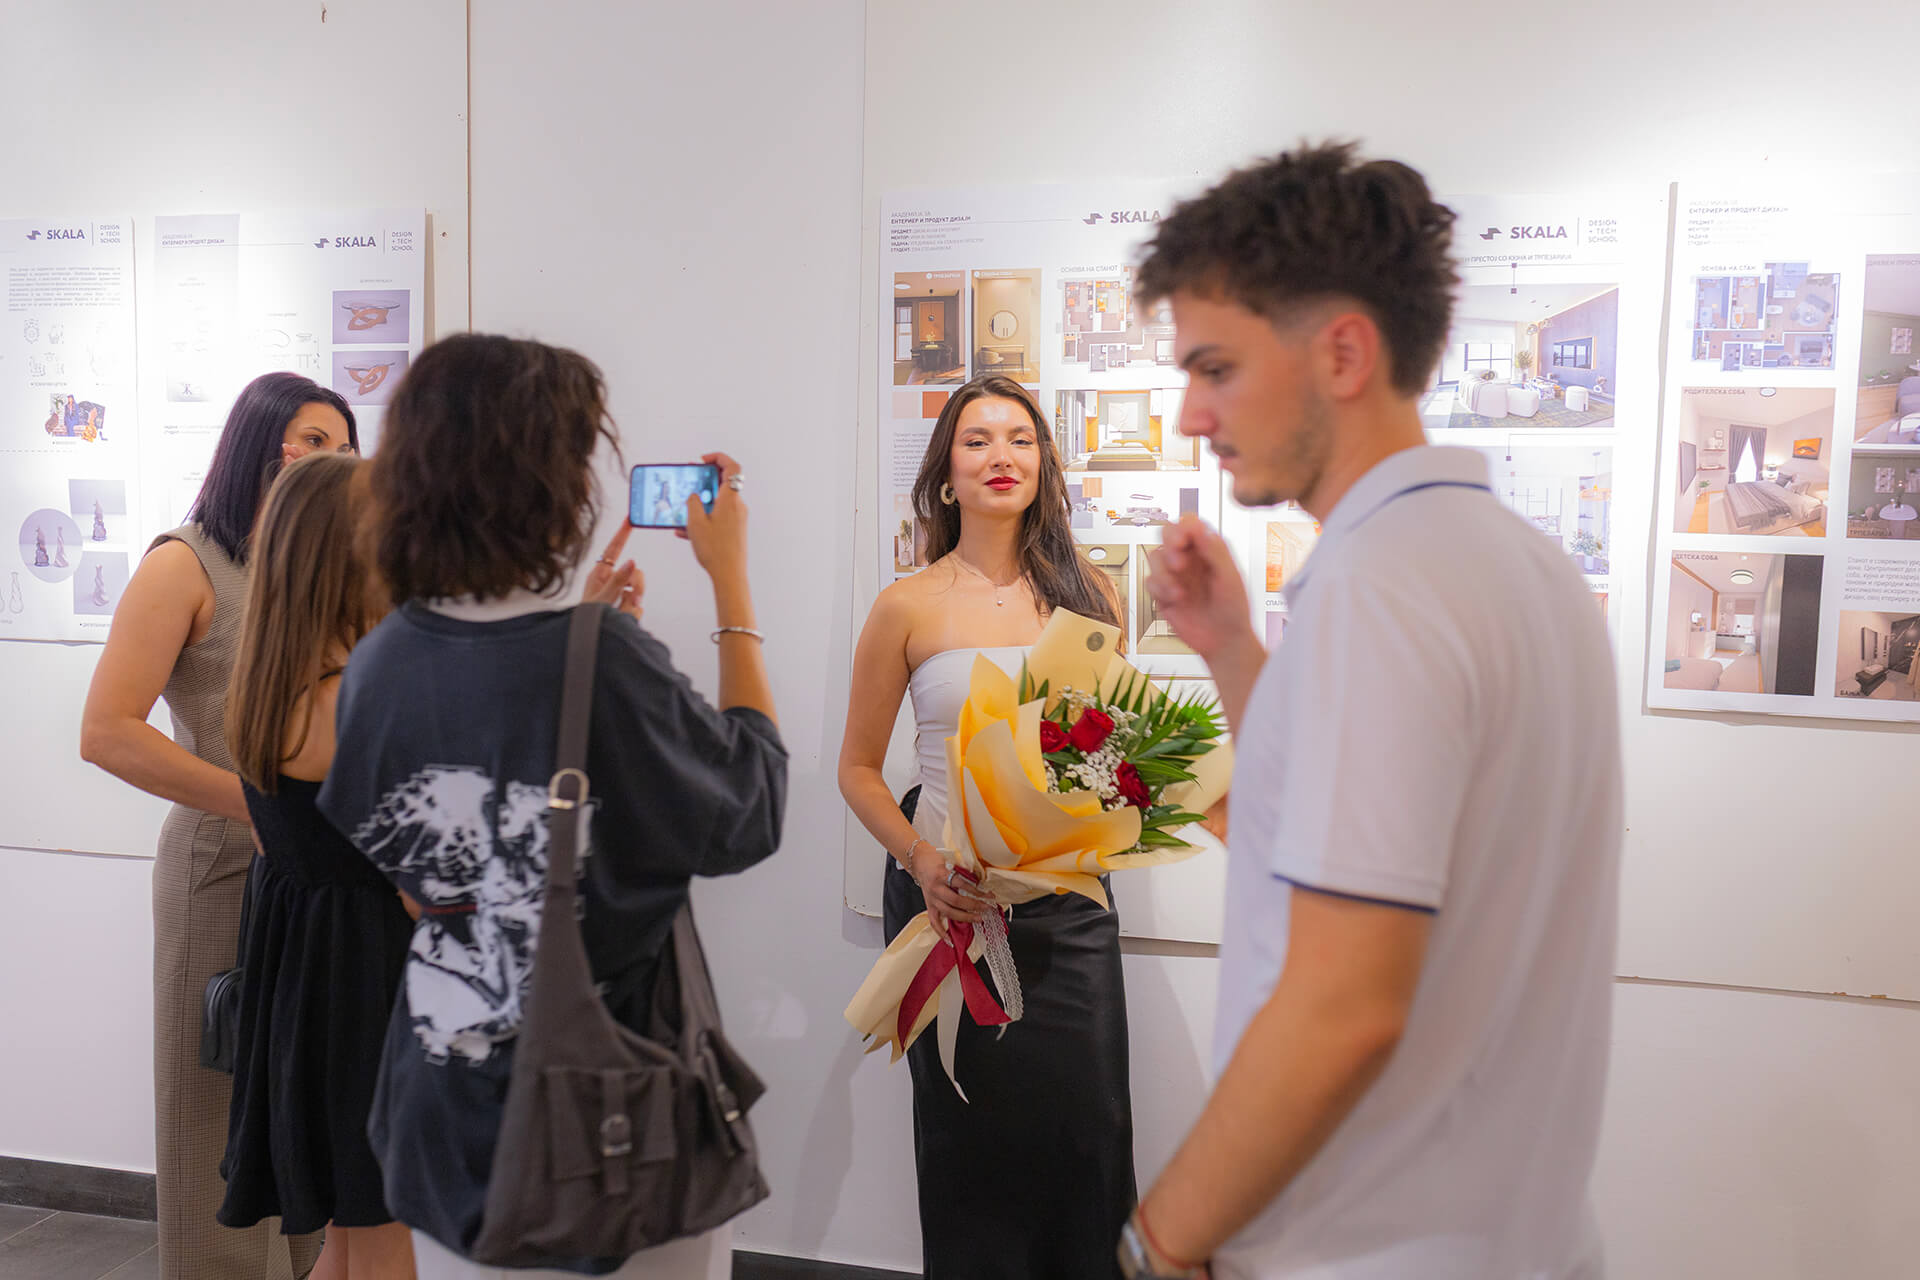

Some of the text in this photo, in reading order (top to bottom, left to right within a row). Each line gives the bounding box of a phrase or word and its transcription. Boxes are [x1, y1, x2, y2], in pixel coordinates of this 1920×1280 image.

[1110, 210, 1161, 224] SKALA
[46, 228, 86, 241] SKALA
[1510, 226, 1568, 240] SKALA
[335, 236, 377, 249] SKALA
[1588, 236, 1619, 244] SCHOOL
